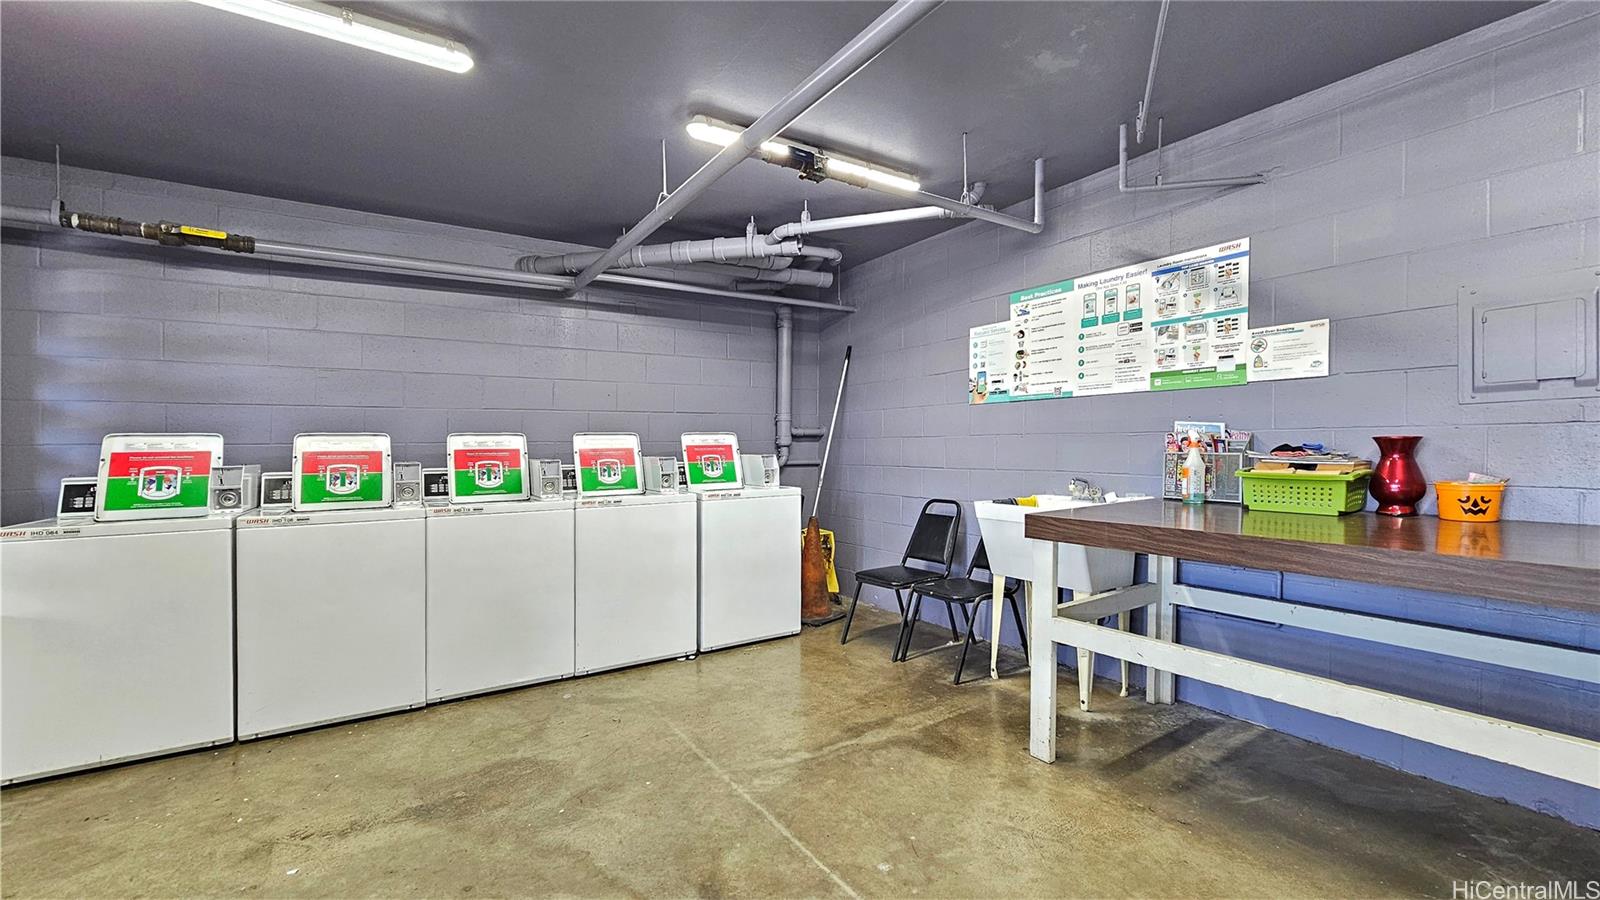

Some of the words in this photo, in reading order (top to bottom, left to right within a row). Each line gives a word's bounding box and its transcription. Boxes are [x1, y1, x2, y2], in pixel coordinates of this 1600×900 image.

[1218, 242, 1242, 253] WASH
[1077, 281, 1099, 290] Making
[1099, 274, 1125, 285] Laundry
[1125, 268, 1148, 279] Easier!
[1020, 293, 1034, 301] Best
[1034, 287, 1063, 298] Practices
